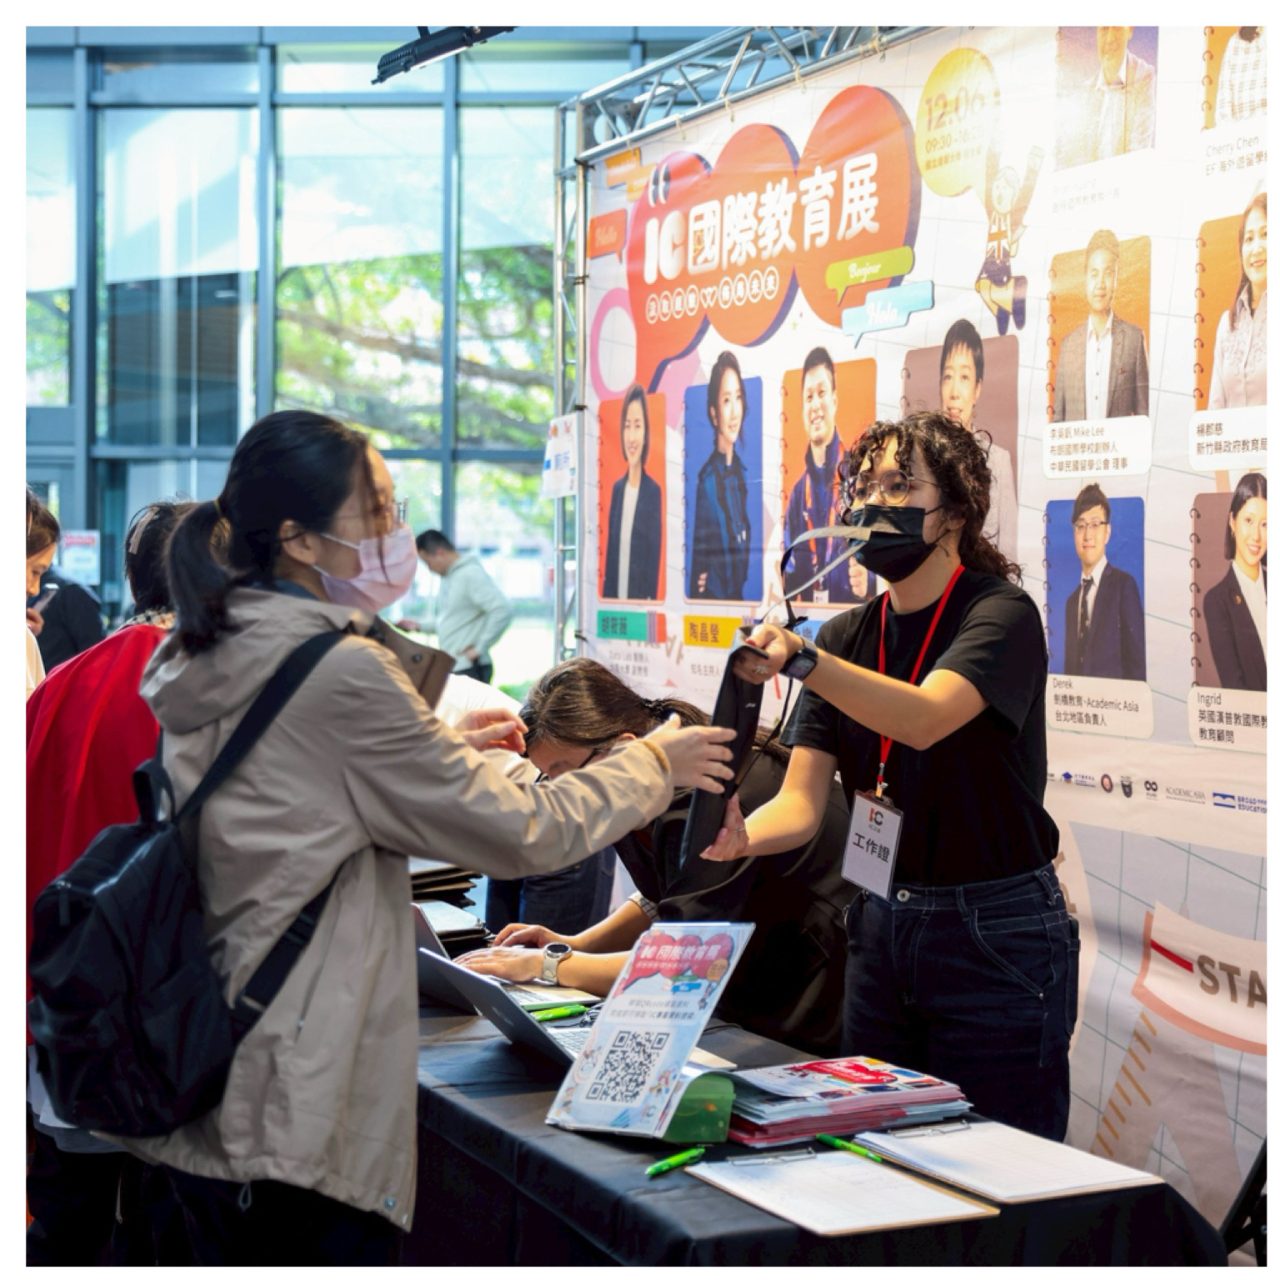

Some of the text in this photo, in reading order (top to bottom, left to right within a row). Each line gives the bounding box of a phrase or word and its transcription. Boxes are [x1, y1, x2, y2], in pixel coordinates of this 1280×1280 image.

[644, 152, 880, 284] IC國際教育展
[847, 263, 882, 282] Bonjour
[865, 301, 900, 326] Hola
[1053, 679, 1073, 689] Derek
[1123, 699, 1140, 713] Asia
[1197, 692, 1222, 707] Ingrid
[852, 832, 890, 863] 工作證
